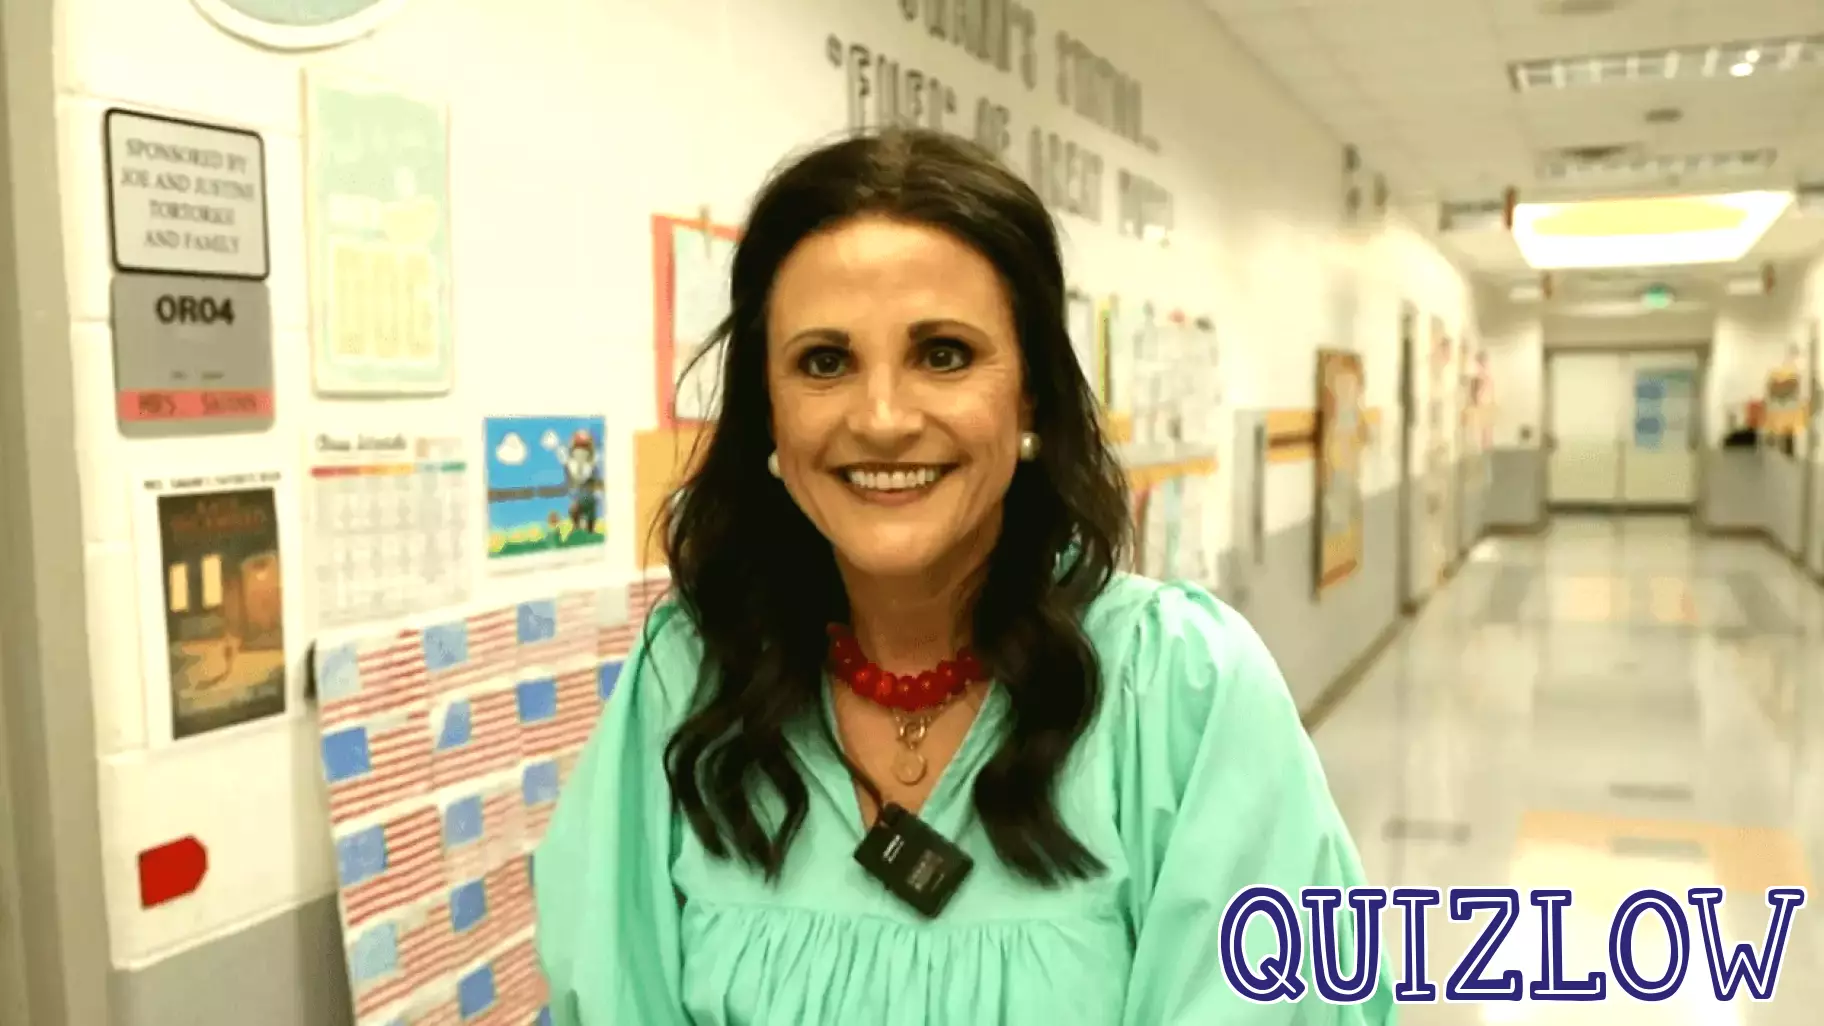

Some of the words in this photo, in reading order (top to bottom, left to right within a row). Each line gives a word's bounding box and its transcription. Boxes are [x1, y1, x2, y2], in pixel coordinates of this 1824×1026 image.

[126, 138, 223, 170] SPONSORED
[226, 152, 247, 174] BY
[120, 167, 149, 188] JOE
[155, 172, 190, 193] AND
[144, 229, 181, 249] AND
[183, 232, 239, 253] FAMILY
